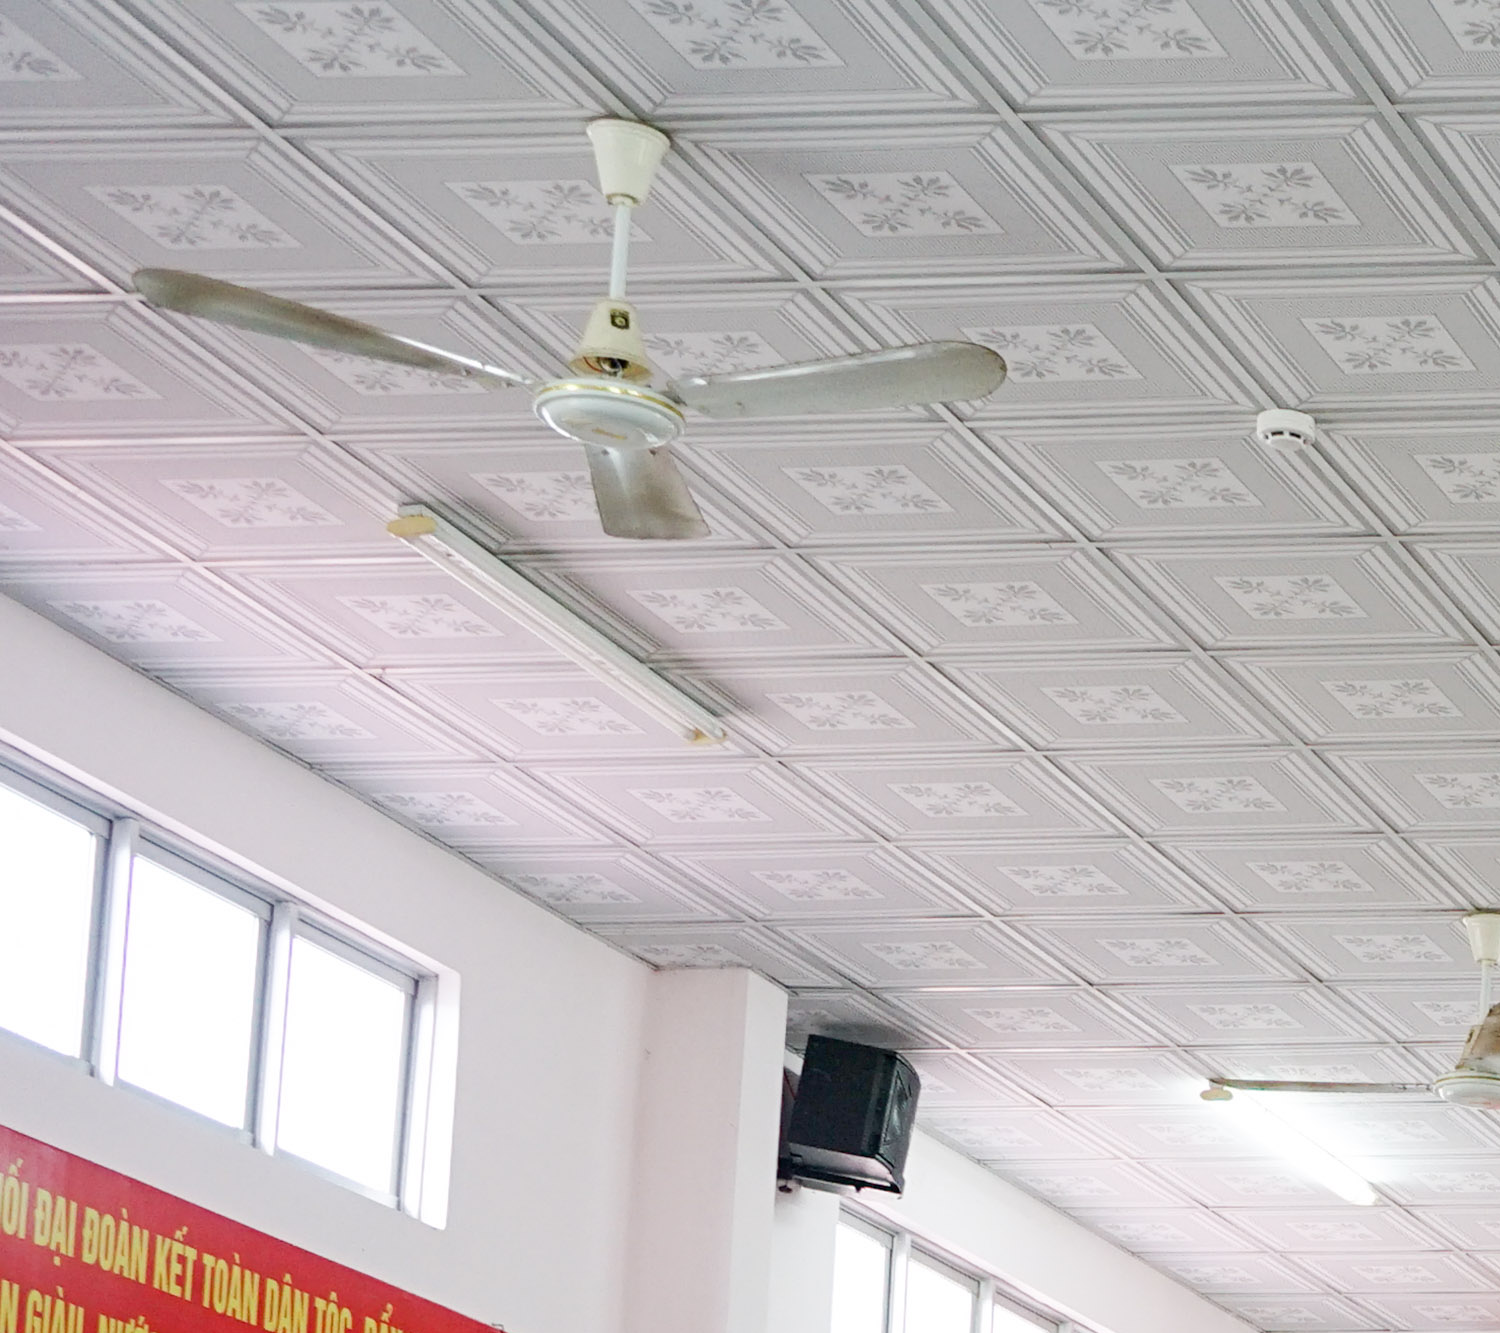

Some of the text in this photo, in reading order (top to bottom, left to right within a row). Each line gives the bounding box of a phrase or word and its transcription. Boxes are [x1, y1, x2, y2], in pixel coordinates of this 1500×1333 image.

[33, 1188, 77, 1265] ĐẠI
[82, 1207, 149, 1283] ĐOÀN
[153, 1226, 197, 1300] KẾT
[202, 1253, 260, 1325] TOÀN
